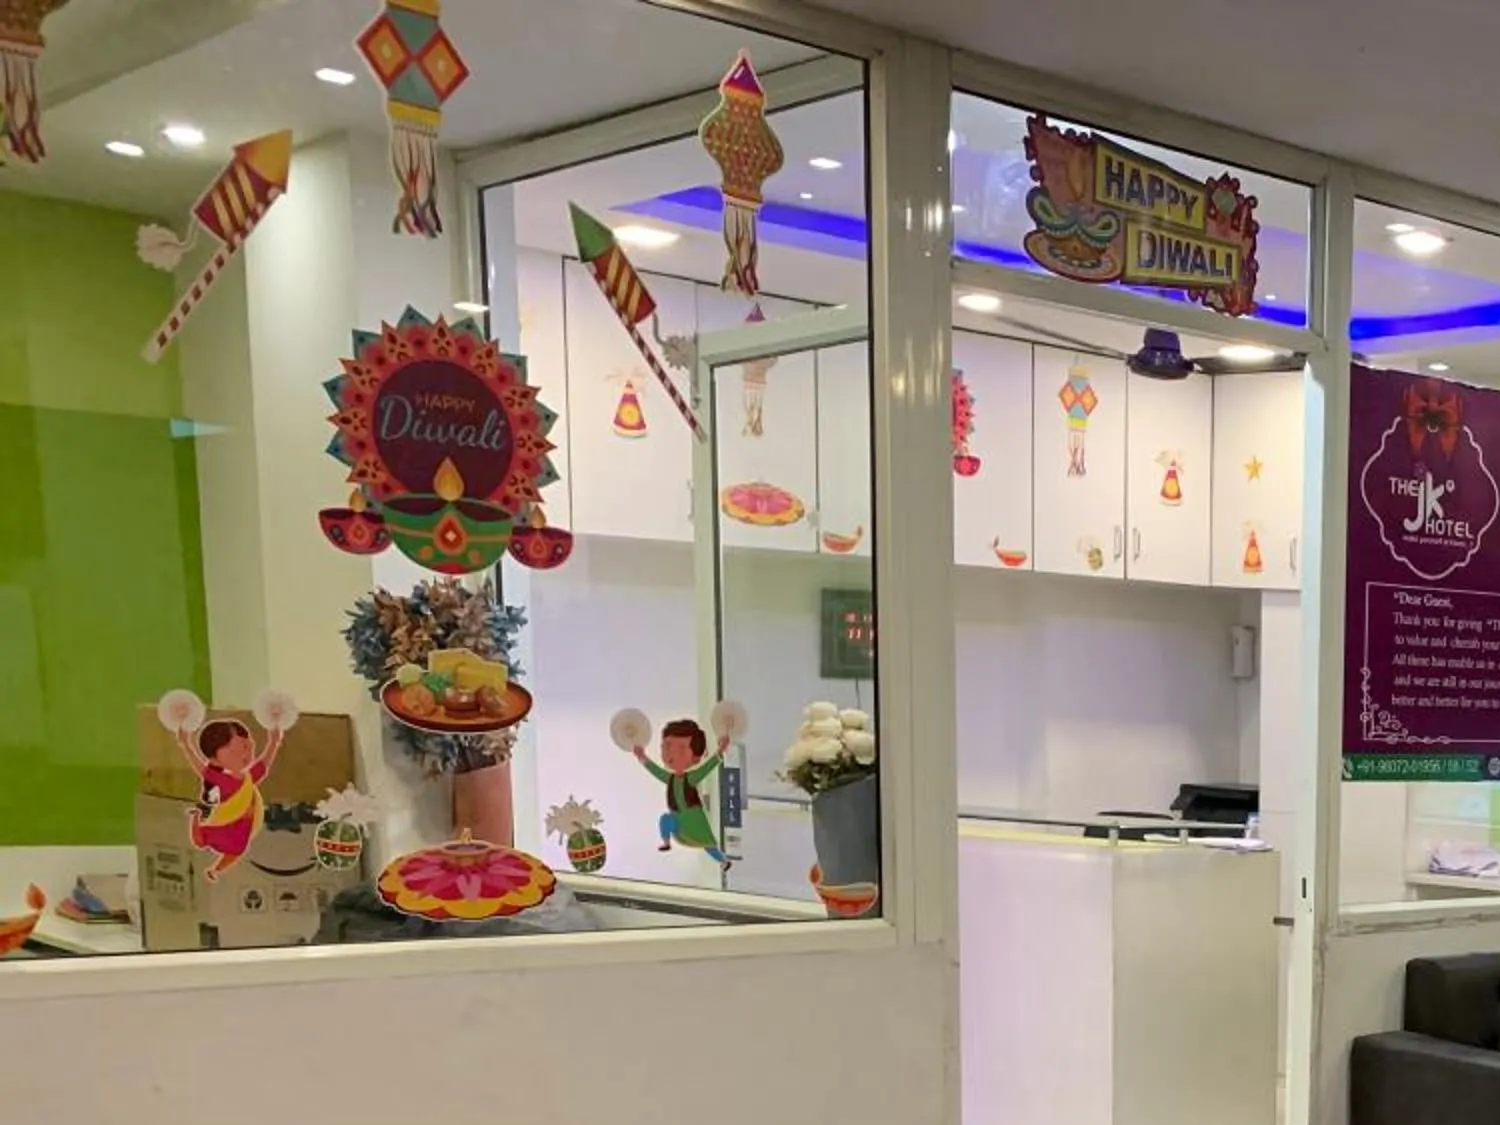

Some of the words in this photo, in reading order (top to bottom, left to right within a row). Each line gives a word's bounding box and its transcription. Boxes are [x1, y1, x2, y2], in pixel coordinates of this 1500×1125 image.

[1104, 156, 1199, 220] HAPPY
[1137, 229, 1233, 277] DIWALI
[415, 392, 476, 413] HAPPY
[379, 394, 507, 450] Diwali
[1388, 476, 1419, 497] THE
[1425, 518, 1475, 539] HOTEL
